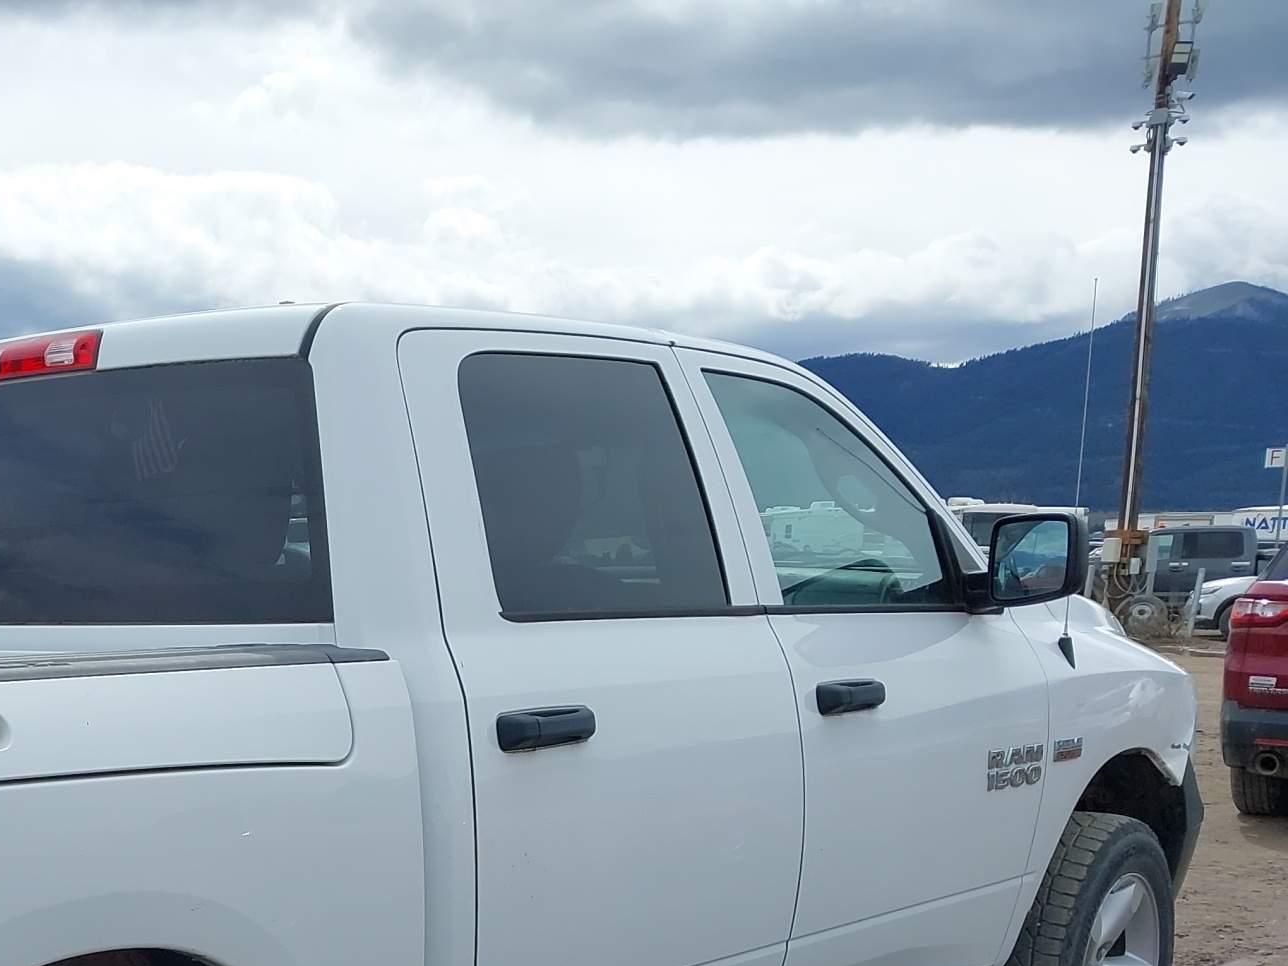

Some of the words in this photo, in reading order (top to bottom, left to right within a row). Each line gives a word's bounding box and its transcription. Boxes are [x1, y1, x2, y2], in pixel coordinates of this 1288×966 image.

[1270, 449, 1283, 466] F
[987, 743, 1044, 770] RAM
[987, 763, 1042, 792] 1500
